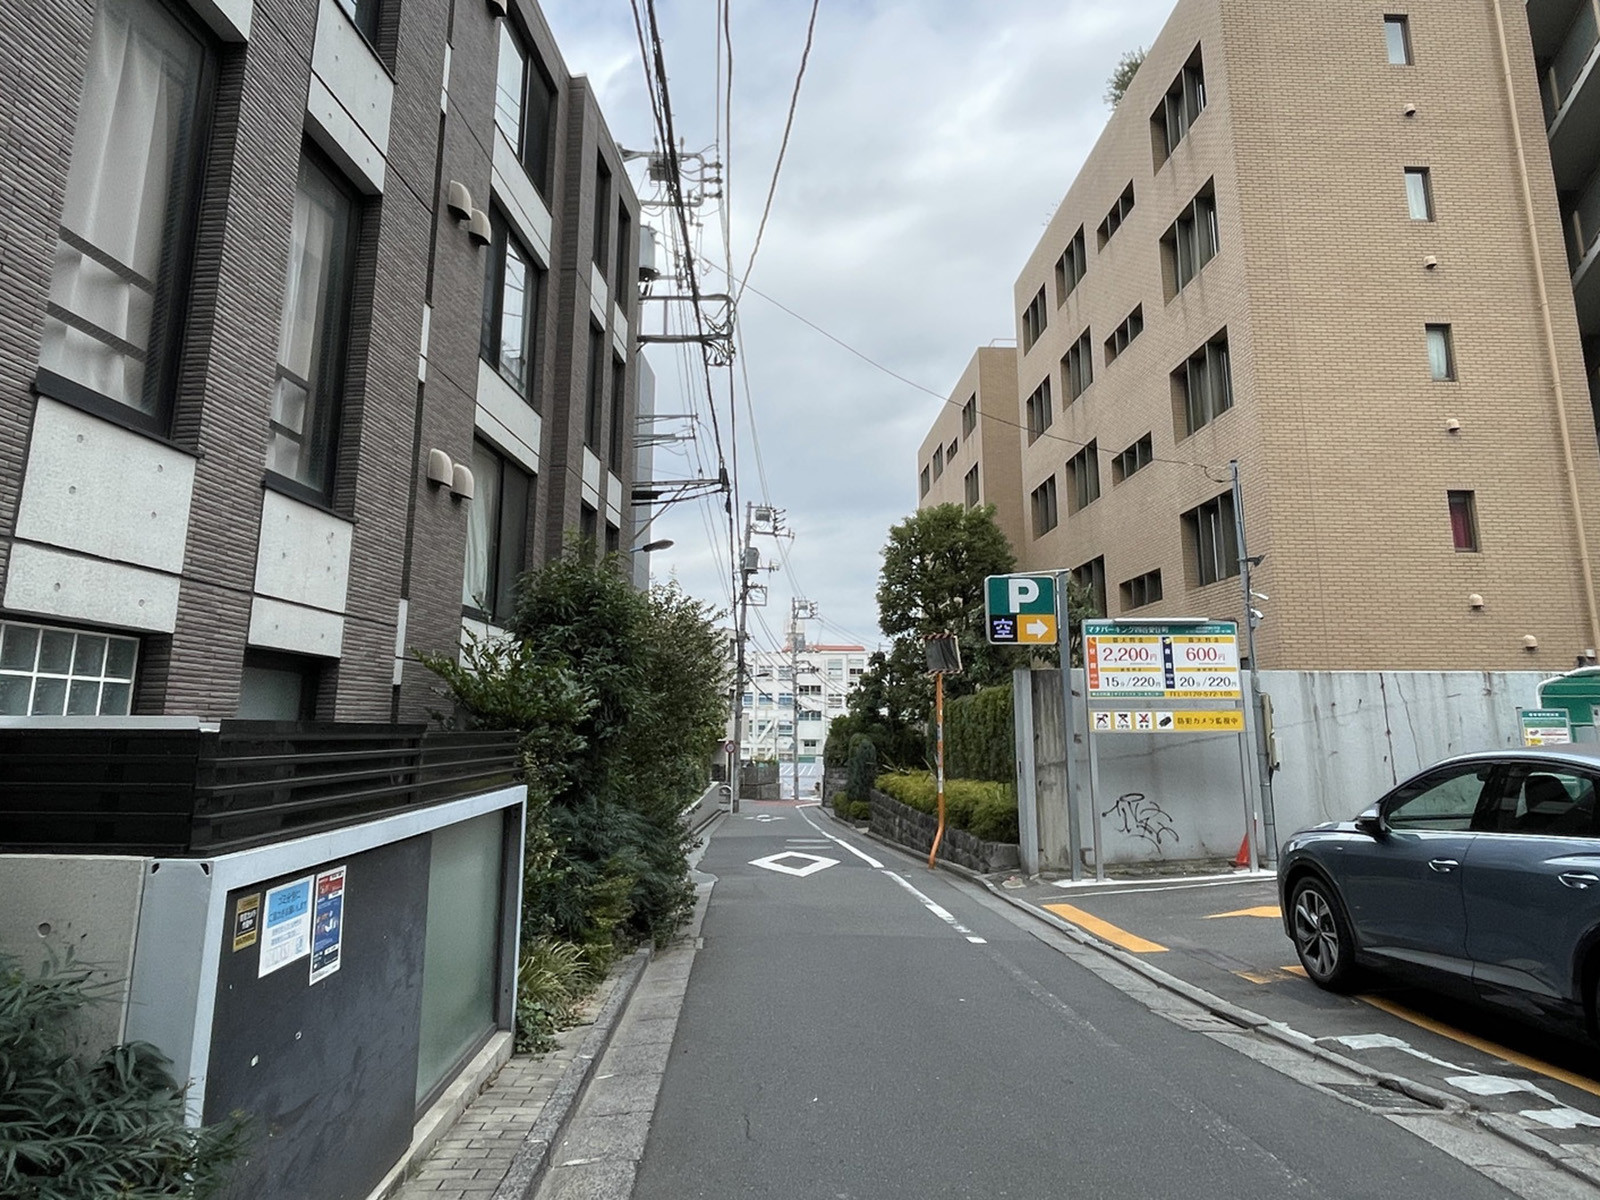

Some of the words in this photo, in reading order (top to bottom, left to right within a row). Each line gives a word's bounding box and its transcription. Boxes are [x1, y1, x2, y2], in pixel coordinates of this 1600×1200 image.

[1008, 578, 1039, 613] P
[993, 618, 1013, 638] 空
[1102, 647, 1157, 662] 2,200円
[1185, 646, 1226, 661] 600円
